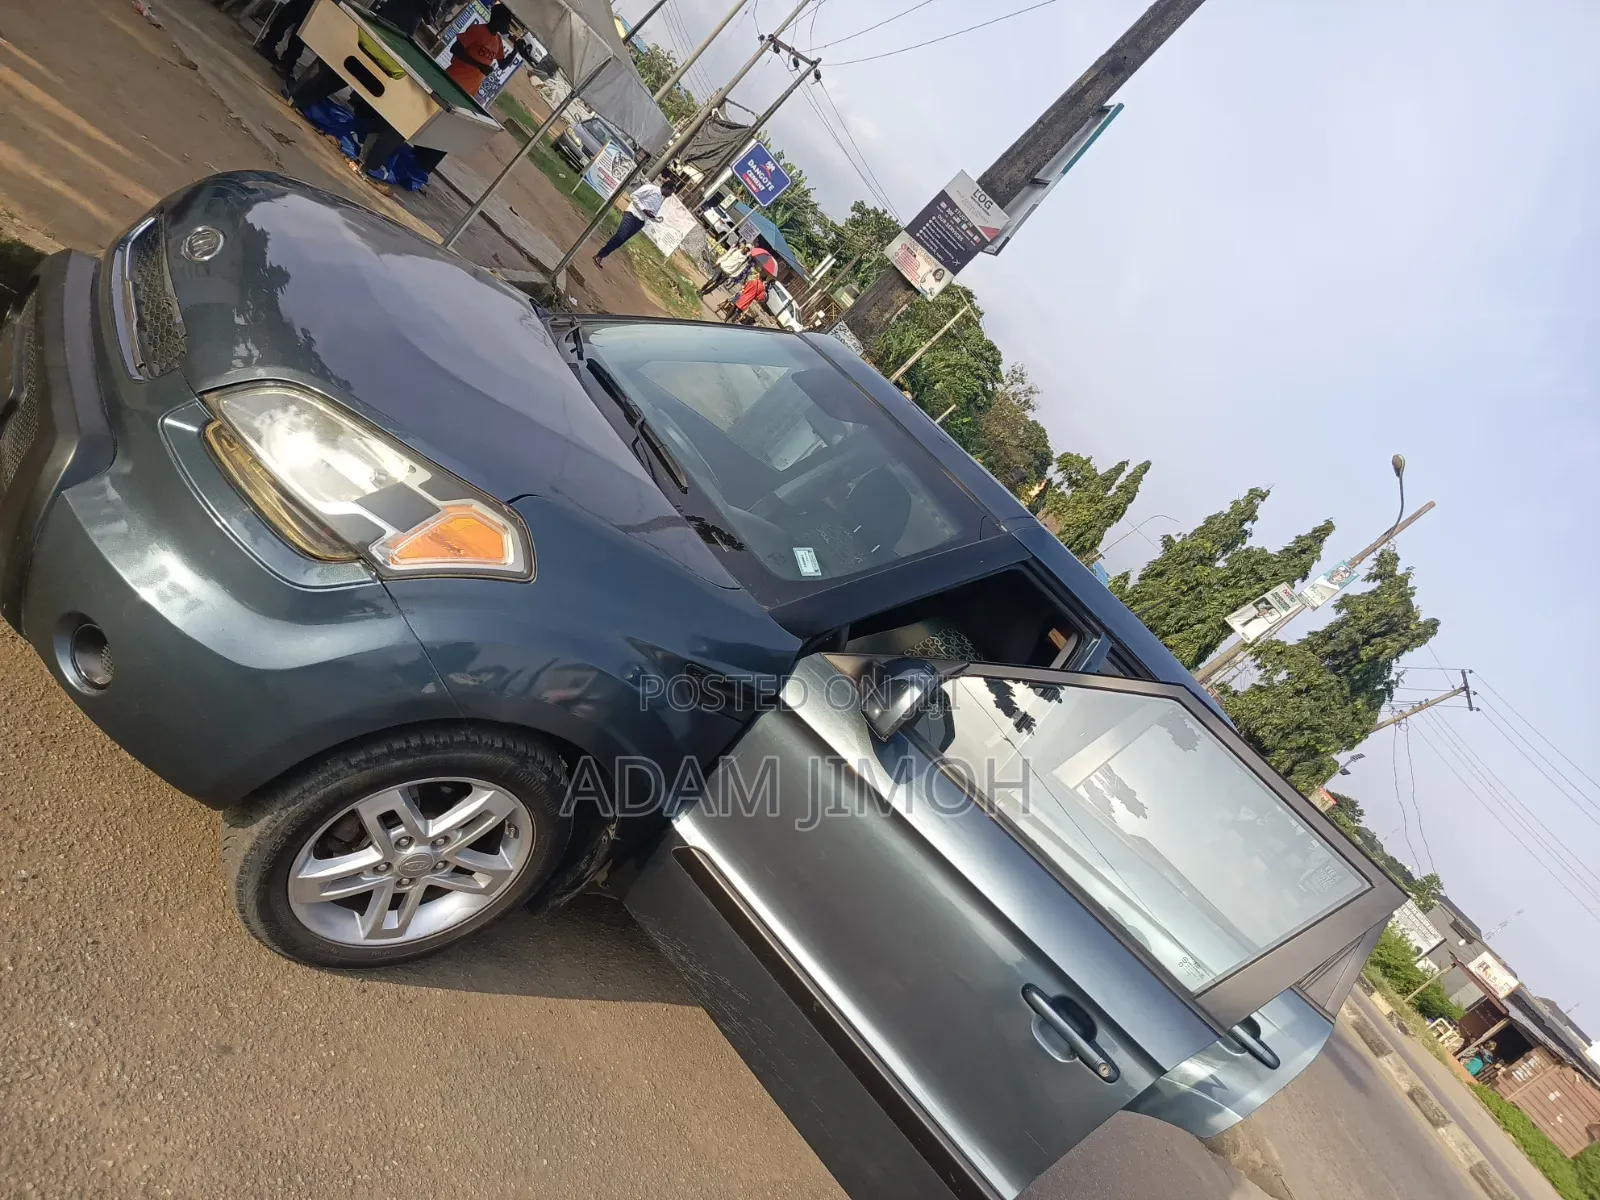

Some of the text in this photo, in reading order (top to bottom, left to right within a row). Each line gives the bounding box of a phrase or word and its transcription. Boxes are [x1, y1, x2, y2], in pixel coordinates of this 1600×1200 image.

[746, 159, 774, 191] DANGOTE
[746, 168, 765, 191] CEMENT
[953, 208, 968, 222] STUDY
[945, 223, 963, 241] SERVICES
